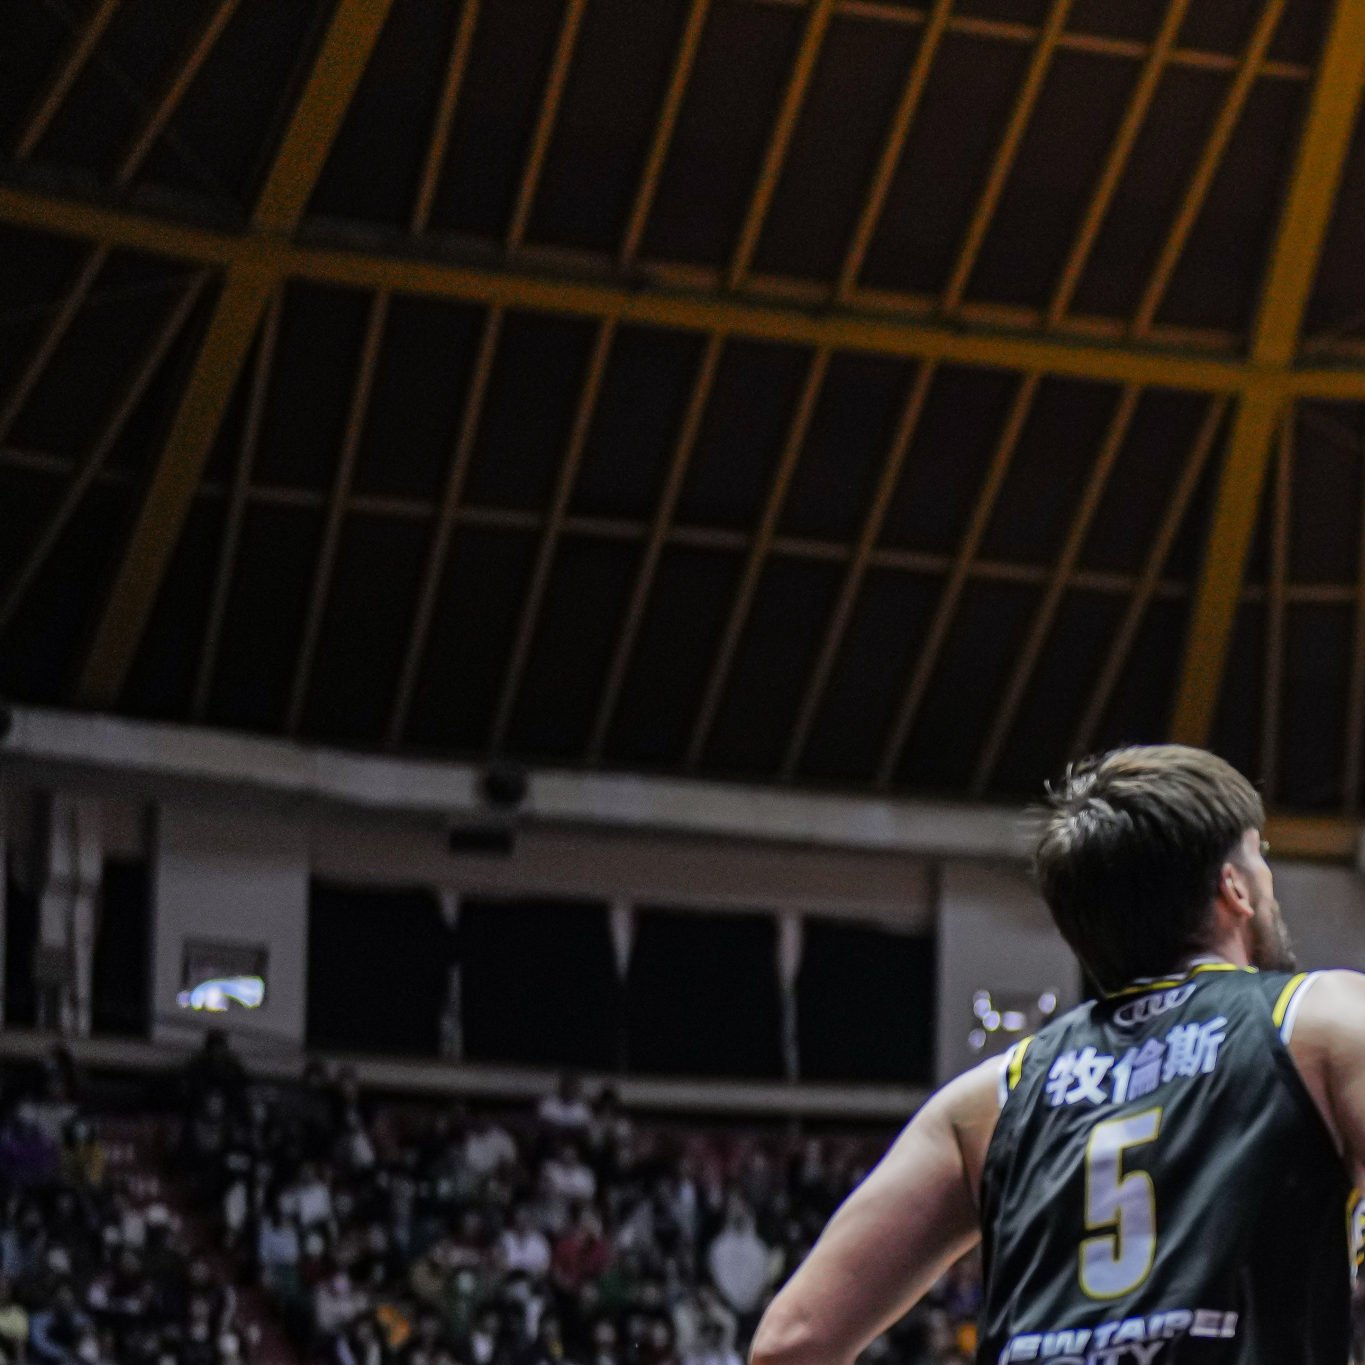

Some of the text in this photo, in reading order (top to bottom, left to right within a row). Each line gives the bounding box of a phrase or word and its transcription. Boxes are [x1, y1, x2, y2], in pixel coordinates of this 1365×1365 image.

[1046, 1016, 1228, 1106] 牧倫斯
[1078, 1106, 1163, 1299] 5
